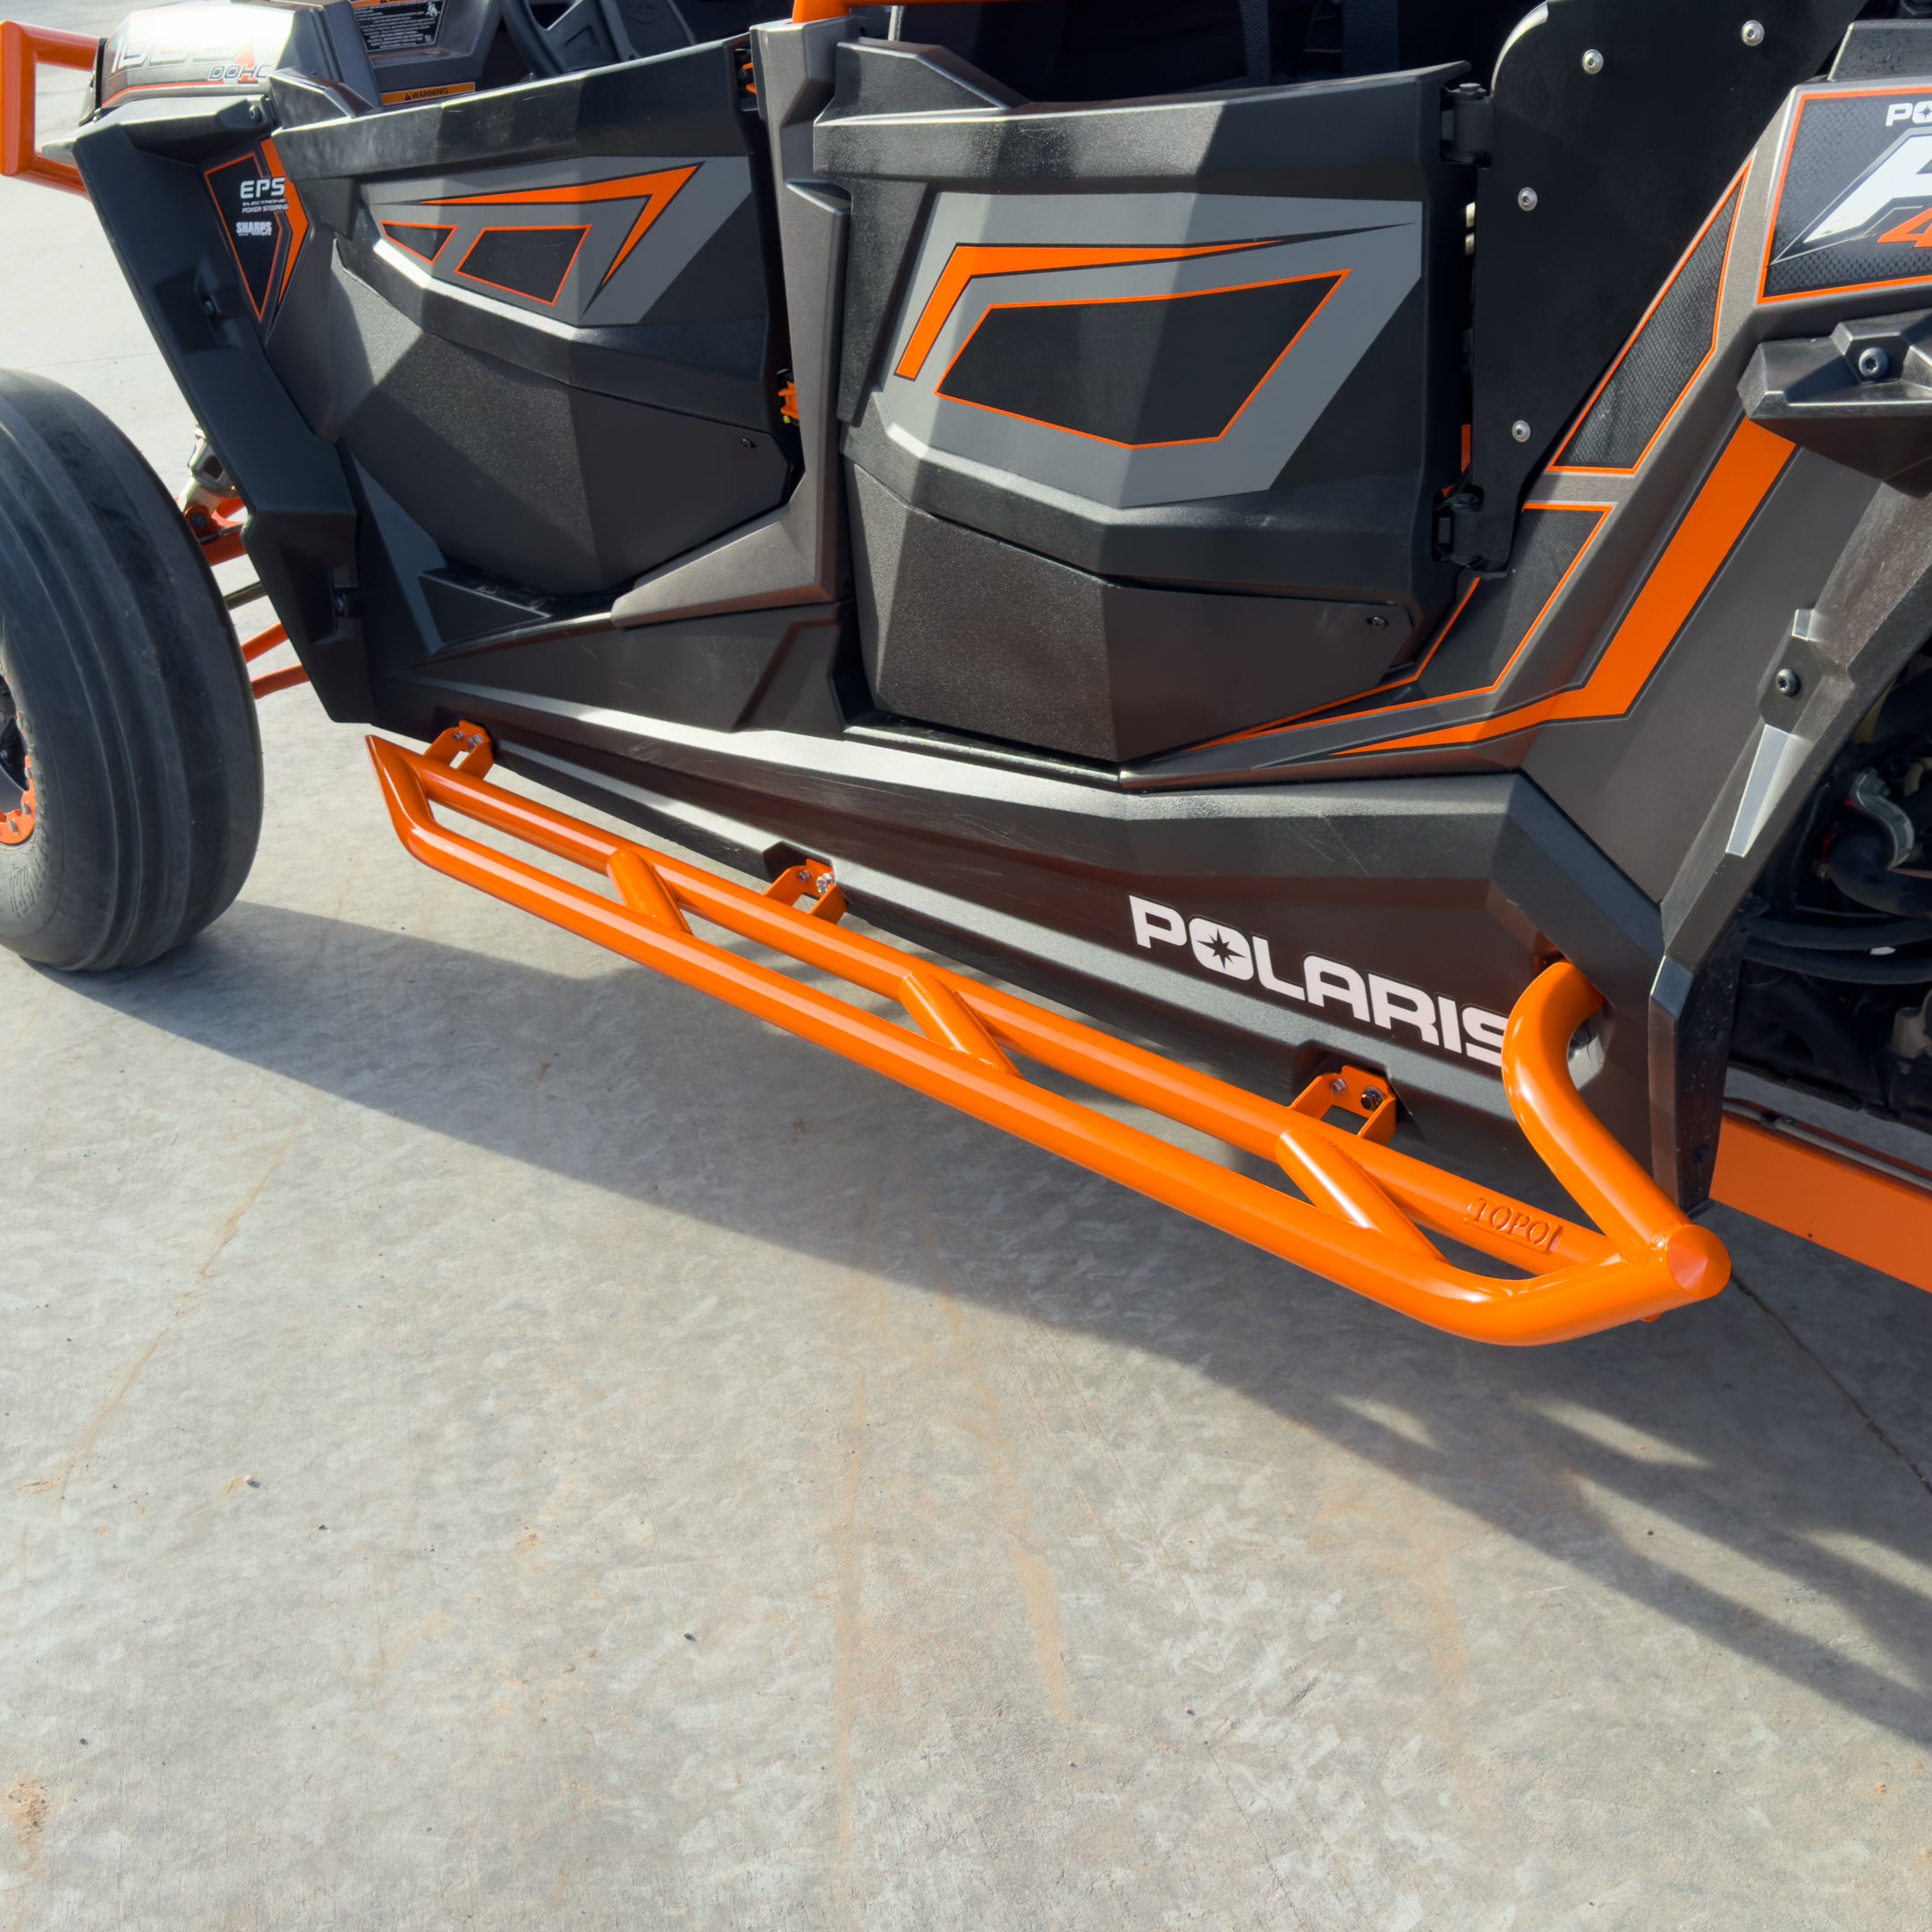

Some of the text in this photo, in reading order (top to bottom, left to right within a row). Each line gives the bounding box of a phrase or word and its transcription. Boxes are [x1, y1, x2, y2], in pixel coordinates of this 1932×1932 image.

[209, 65, 272, 80] DOHC
[411, 88, 450, 99] WARNING
[240, 177, 286, 199] EPS
[242, 199, 288, 207] ELECTRONIC
[1129, 894, 1510, 1067] POLARIS
